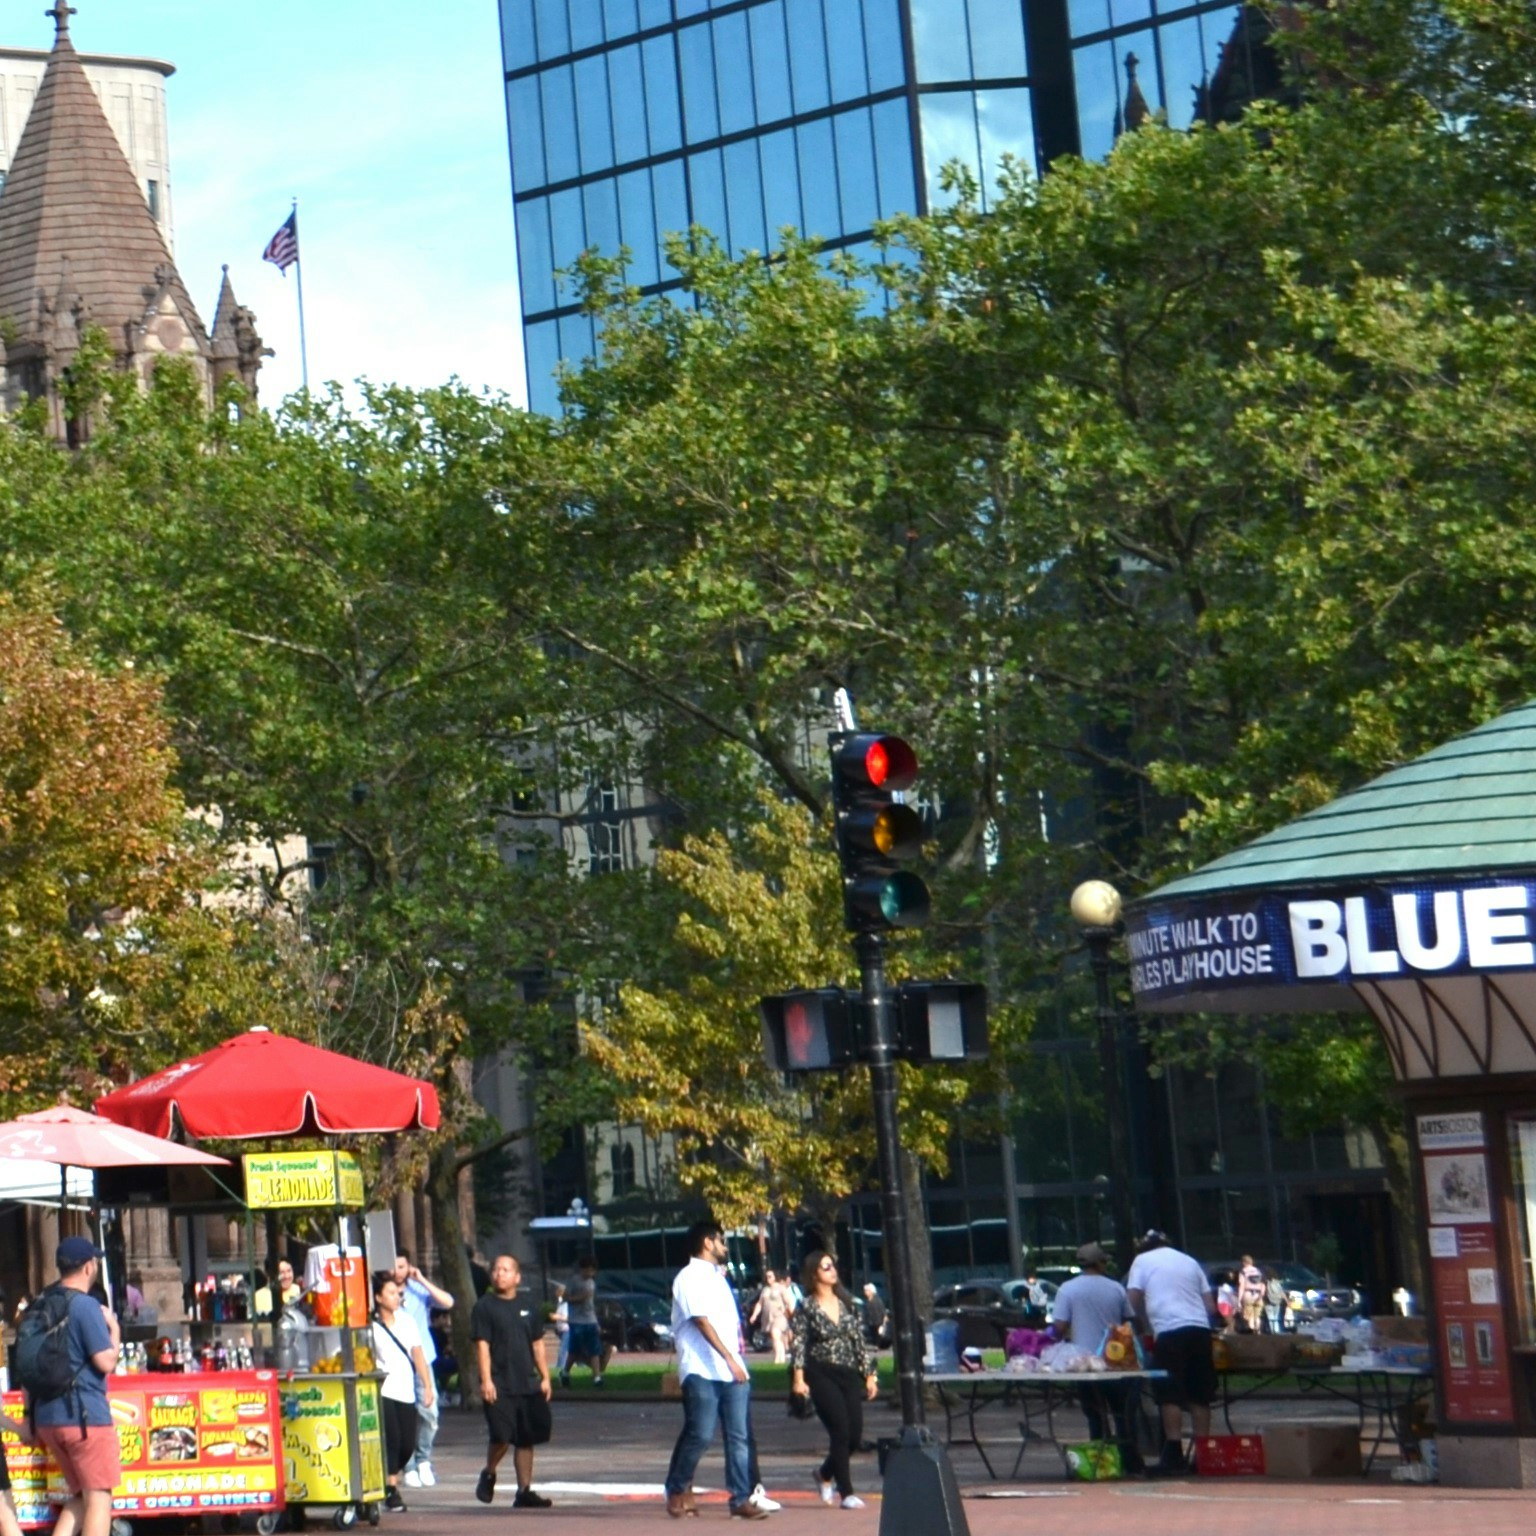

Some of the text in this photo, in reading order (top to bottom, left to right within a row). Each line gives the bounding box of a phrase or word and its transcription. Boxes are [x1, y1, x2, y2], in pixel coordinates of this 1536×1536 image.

[1172, 916, 1223, 950] WALK
[1228, 912, 1258, 941] TO
[1289, 886, 1534, 977] BLUE
[1163, 944, 1273, 984] PLAYHOUSE
[269, 1176, 334, 1202] LEMONADE
[126, 1475, 246, 1494] LEMONADE
